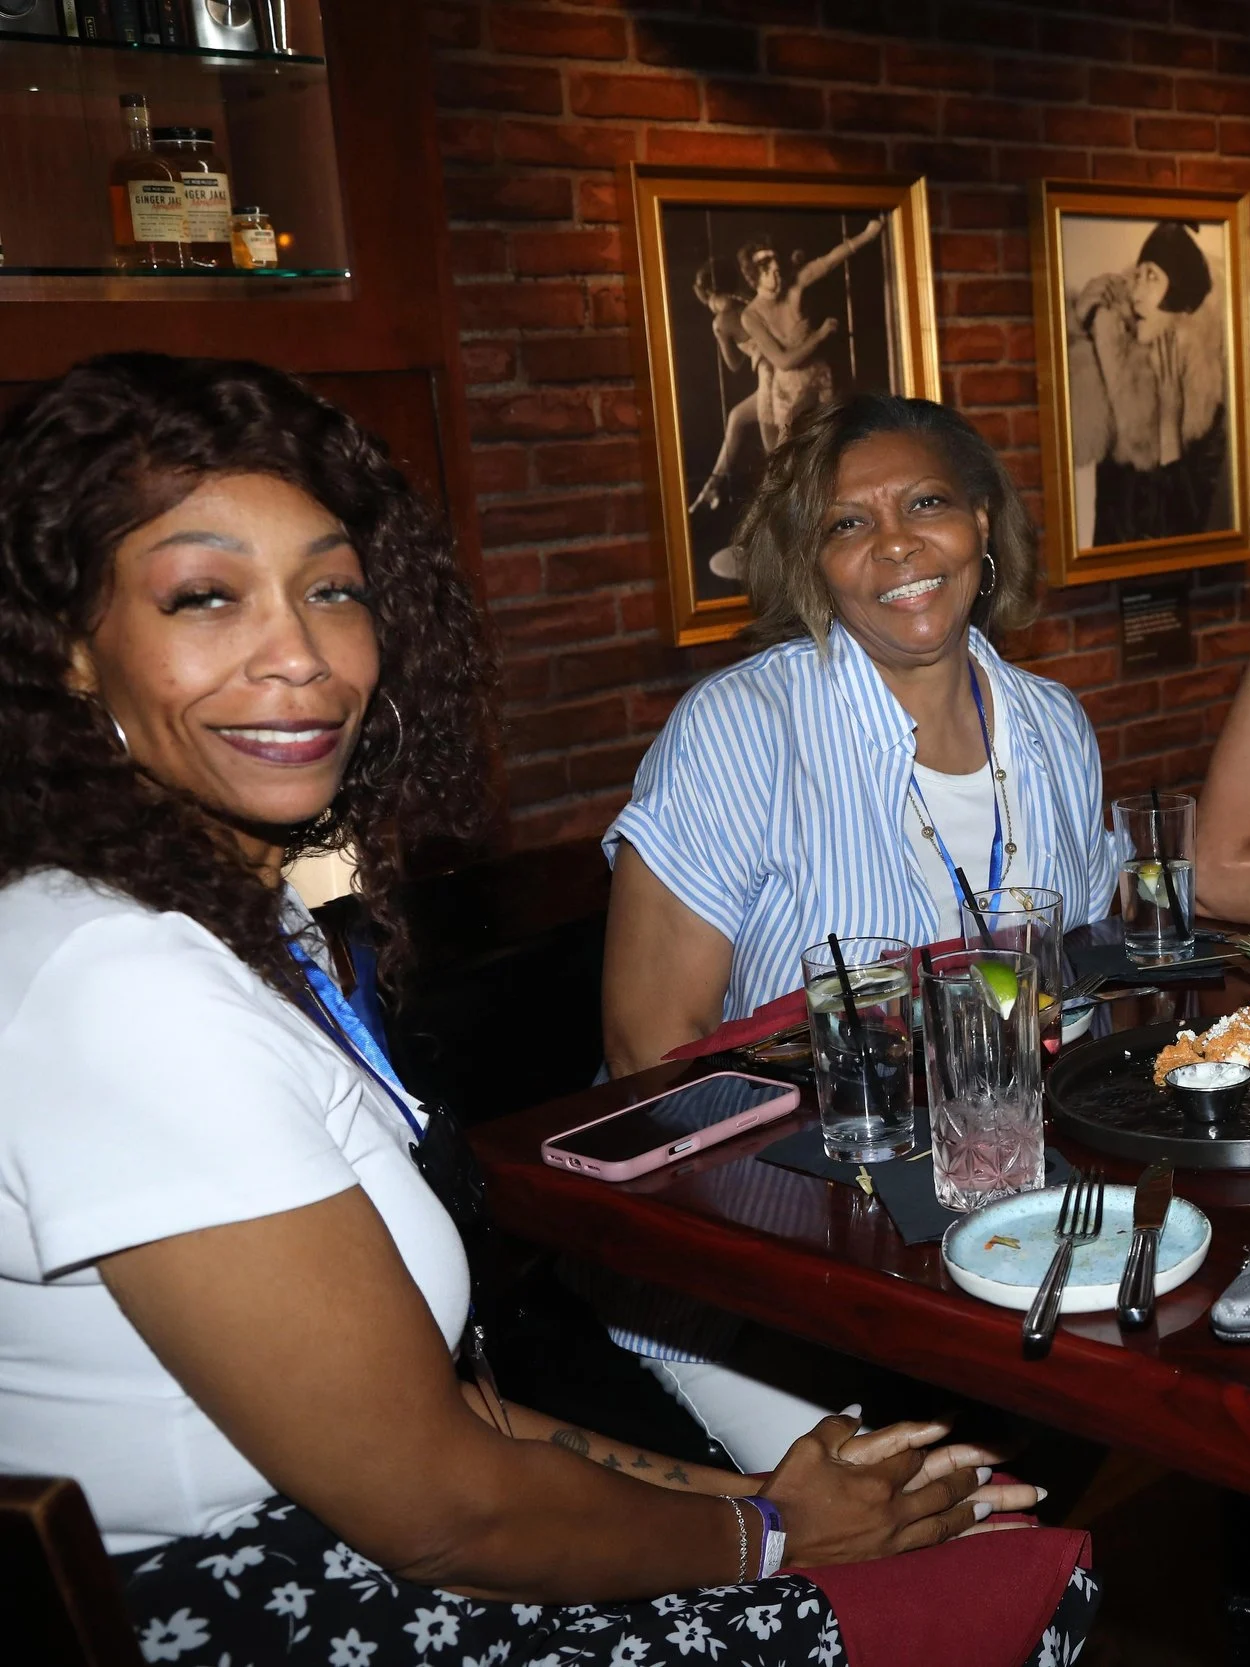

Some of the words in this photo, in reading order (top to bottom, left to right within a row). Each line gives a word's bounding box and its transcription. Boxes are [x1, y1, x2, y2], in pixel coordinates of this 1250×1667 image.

[135, 195, 165, 204] GINGER
[168, 197, 182, 205] JAKE
[185, 190, 206, 199] NGER
[210, 190, 226, 200] JAKE
